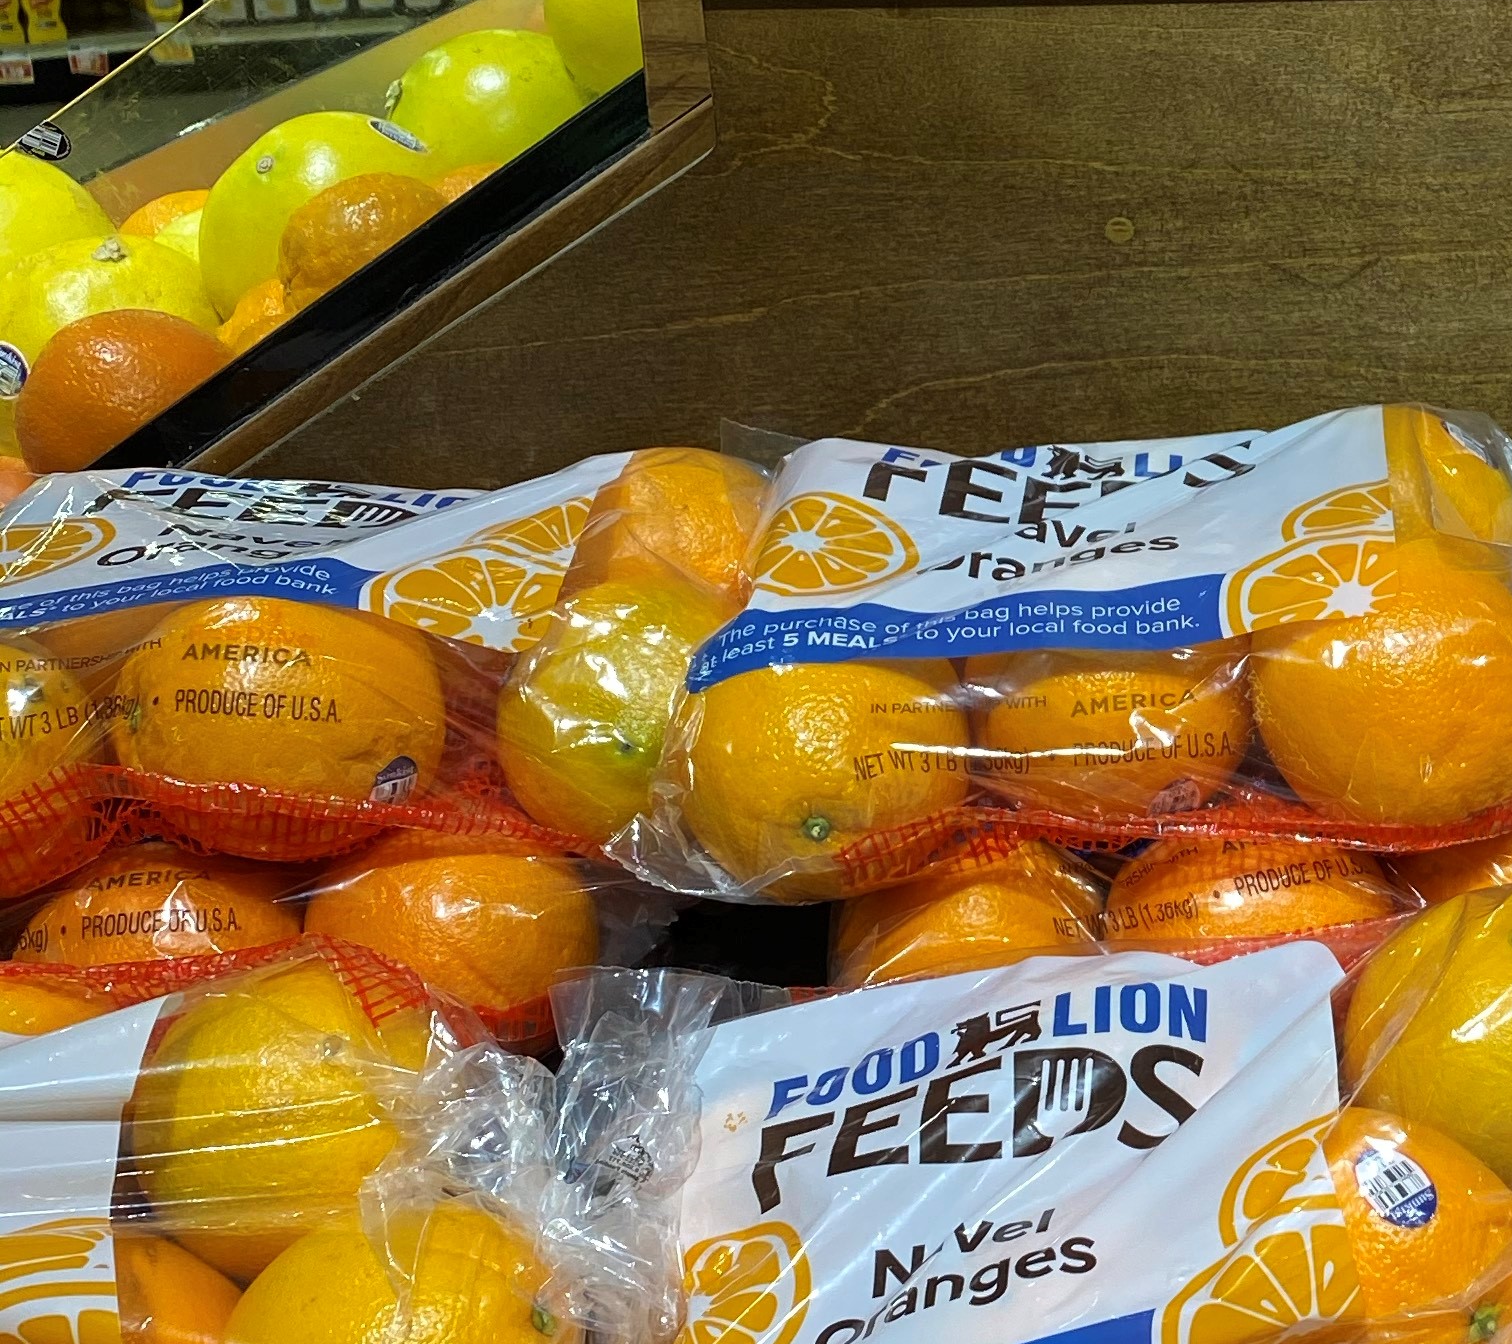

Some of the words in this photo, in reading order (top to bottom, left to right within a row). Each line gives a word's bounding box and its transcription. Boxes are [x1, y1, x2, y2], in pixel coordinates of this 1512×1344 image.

[1093, 596, 1181, 619] provide
[1134, 612, 1200, 635] bank.
[182, 643, 312, 666] AMERICA
[175, 688, 259, 718] PRODUCE
[264, 695, 286, 718] OF
[290, 696, 342, 723] U.S.A.
[1071, 689, 1198, 718] AMERICA
[765, 1031, 940, 1119] FOOD
[1053, 982, 1207, 1043] LION
[752, 1045, 1205, 1215] FEEDS
[871, 1208, 1055, 1298] Nvel
